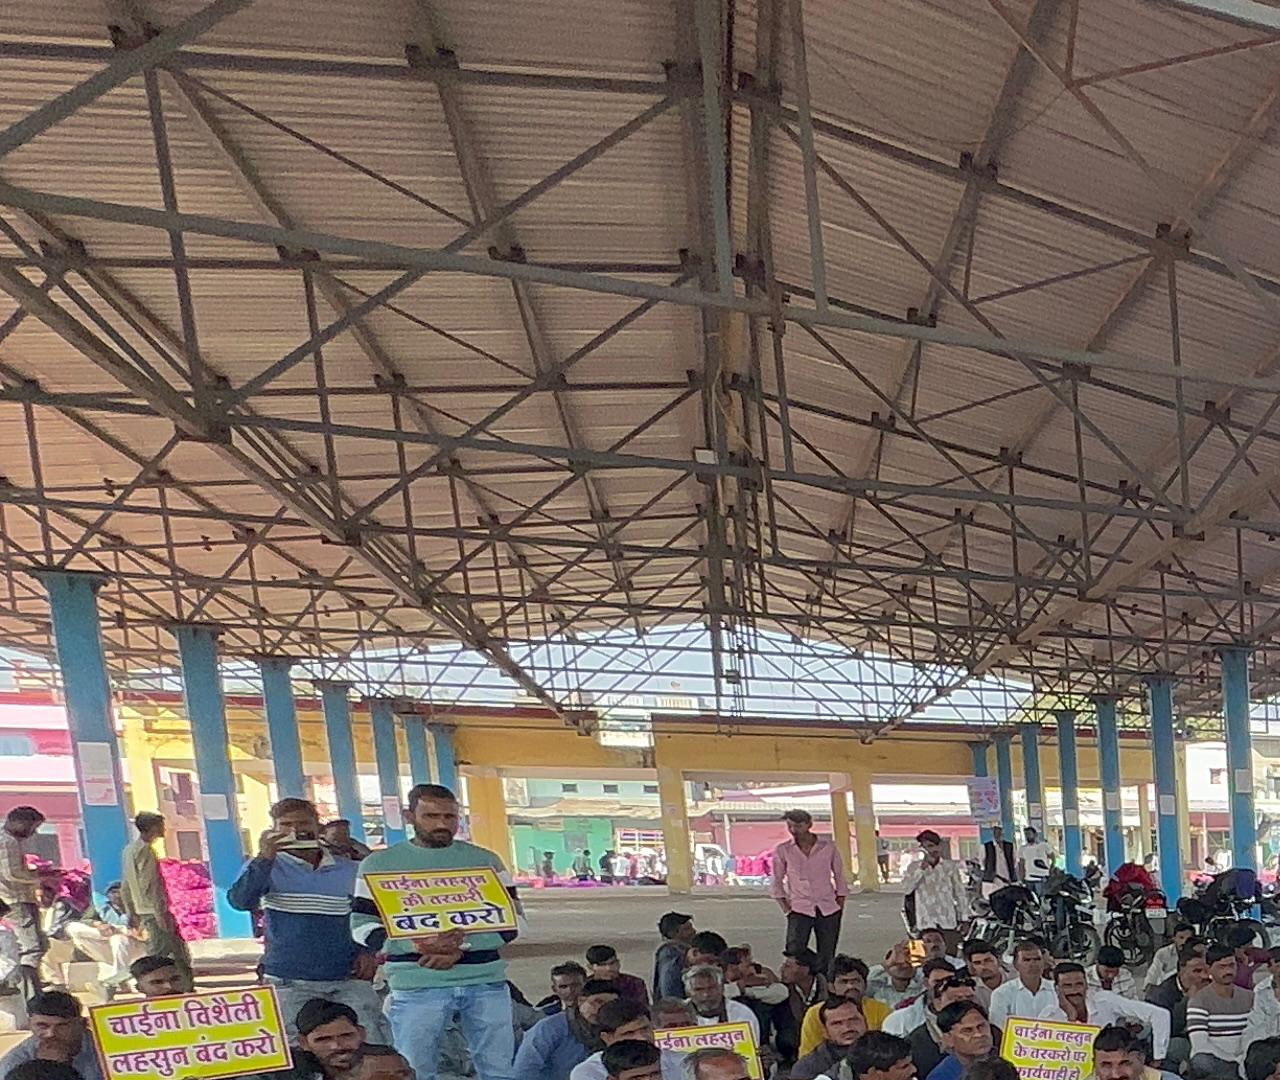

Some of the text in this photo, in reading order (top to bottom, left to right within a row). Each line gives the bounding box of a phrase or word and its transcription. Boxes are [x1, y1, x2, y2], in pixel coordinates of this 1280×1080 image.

[379, 875, 487, 892] चाईना लहसुन
[401, 893, 424, 907] की
[393, 902, 506, 930] बंद करो
[108, 993, 262, 1036] चाईना विशैली
[1015, 1023, 1052, 1040] चाईना
[109, 1029, 277, 1076] लहसुन बंद करो
[1014, 1042, 1028, 1057] के
